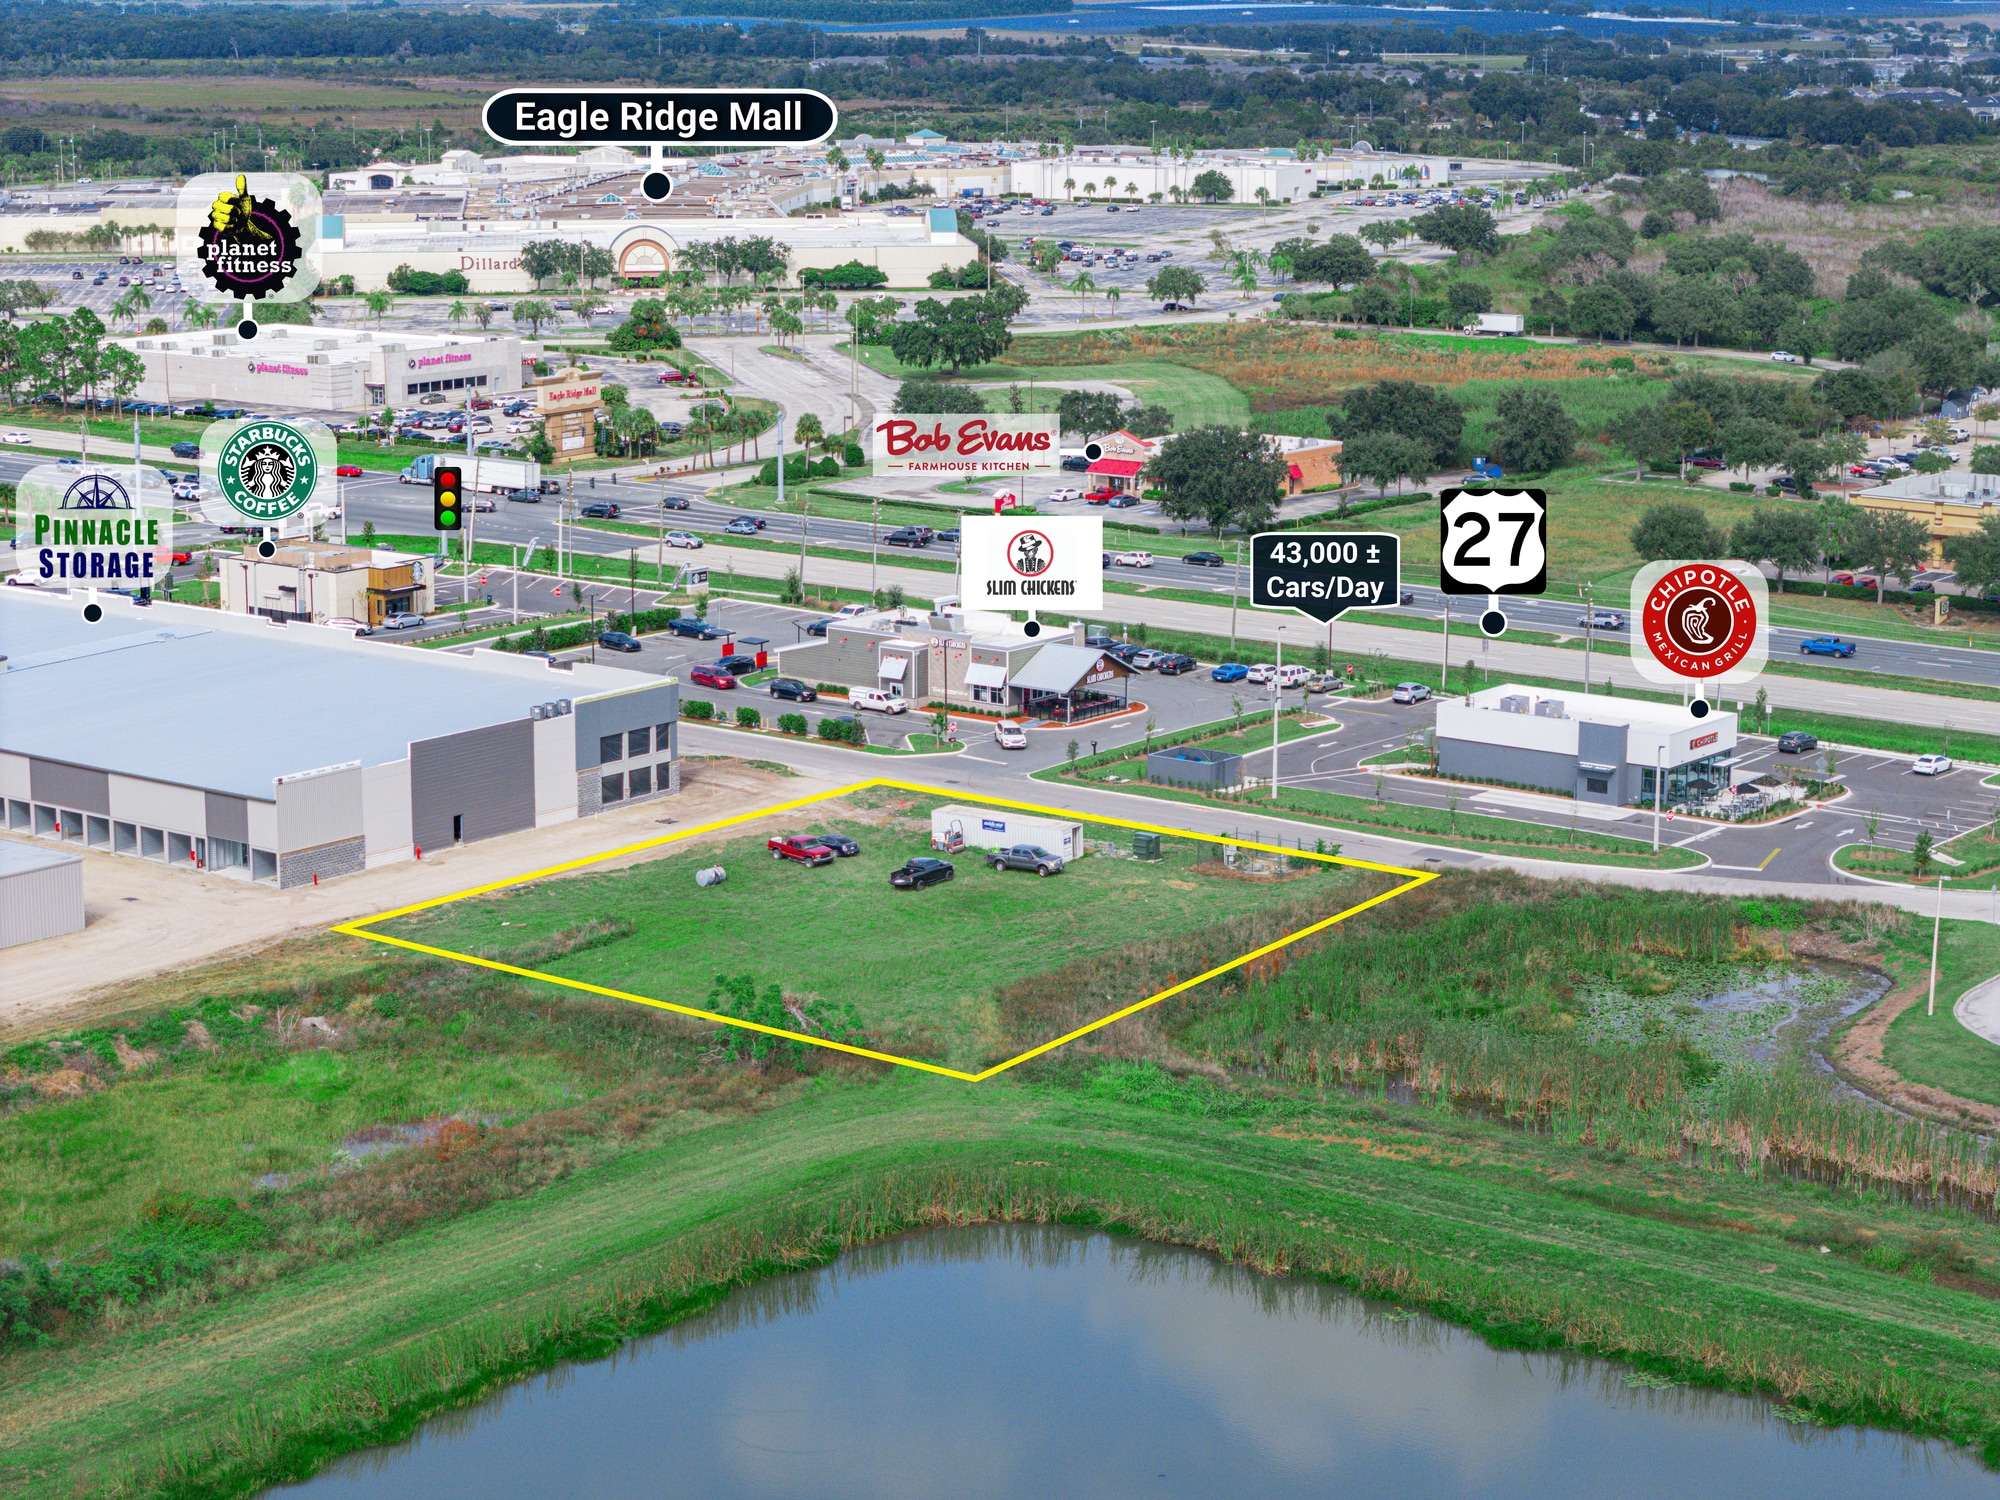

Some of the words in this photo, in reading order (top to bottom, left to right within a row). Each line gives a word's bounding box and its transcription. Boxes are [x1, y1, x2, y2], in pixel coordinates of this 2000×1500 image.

[417, 355, 444, 369] planet
[445, 353, 472, 363] fitness
[549, 391, 565, 402] Eagle
[584, 386, 597, 395] Mall
